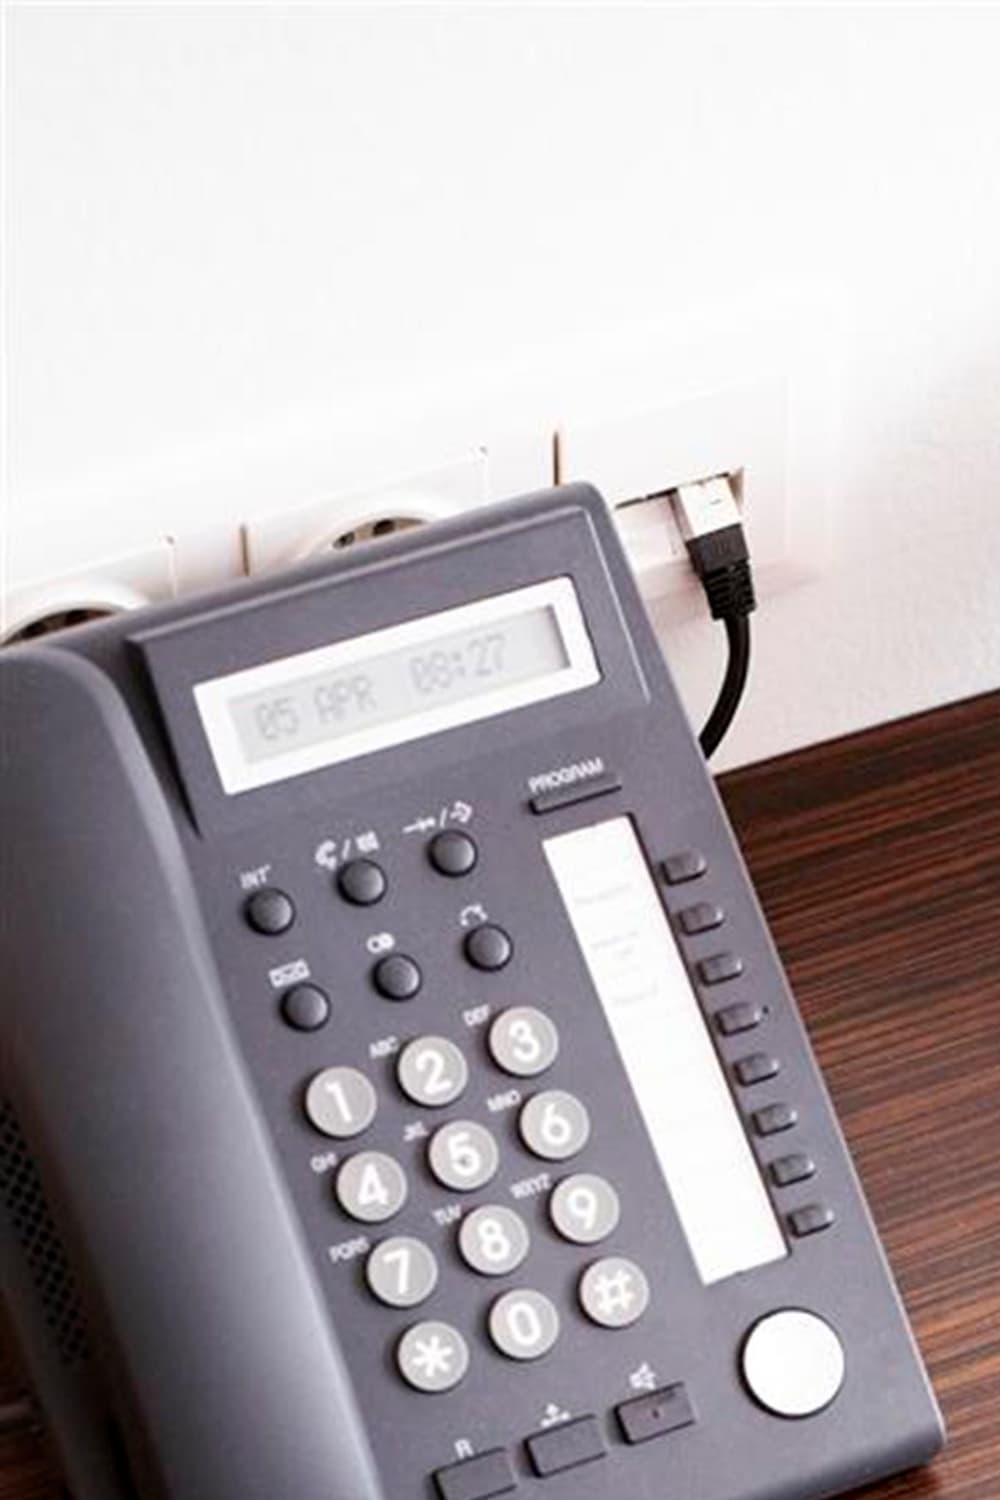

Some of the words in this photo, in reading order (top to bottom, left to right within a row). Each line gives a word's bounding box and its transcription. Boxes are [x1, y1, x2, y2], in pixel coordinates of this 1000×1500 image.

[254, 697, 300, 742] 05
[313, 674, 379, 726] APR
[409, 634, 508, 695] 08:27
[528, 757, 605, 794] PROGRAM
[508, 1019, 539, 1063] 3
[415, 1049, 452, 1094] 2
[324, 1079, 353, 1123] 1
[539, 1103, 572, 1145] 6
[447, 1131, 481, 1176] 5
[357, 1164, 390, 1207] 4
[565, 1186, 597, 1231] 9
[476, 1217, 512, 1263] 8
[382, 1248, 411, 1296] 7
[506, 1301, 541, 1346] 0
